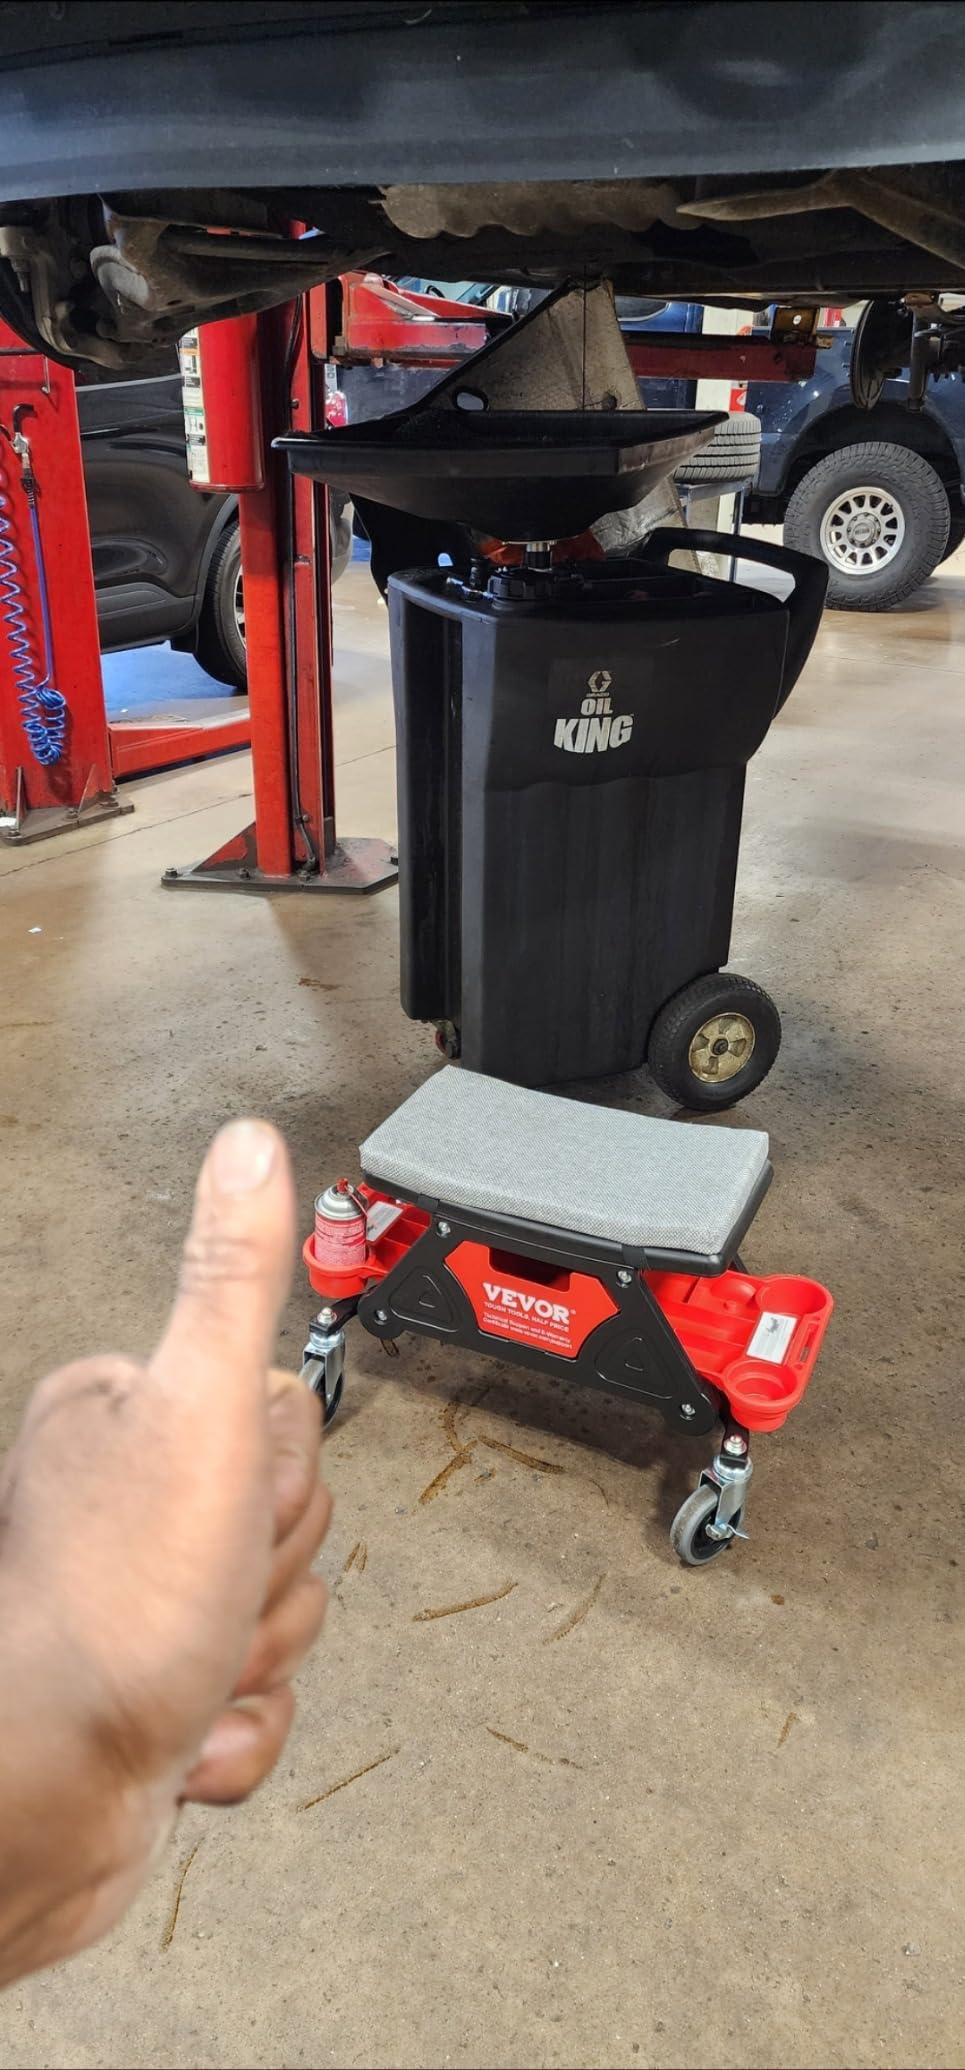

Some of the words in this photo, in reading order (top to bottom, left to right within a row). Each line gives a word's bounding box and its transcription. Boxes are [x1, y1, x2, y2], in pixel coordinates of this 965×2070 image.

[581, 698, 613, 716] OIL
[553, 715, 634, 754] KING
[482, 1282, 570, 1326] VEVOR
[484, 1301, 507, 1312] TOUGH
[531, 1316, 549, 1326] HALF
[549, 1321, 569, 1332] PRICE
